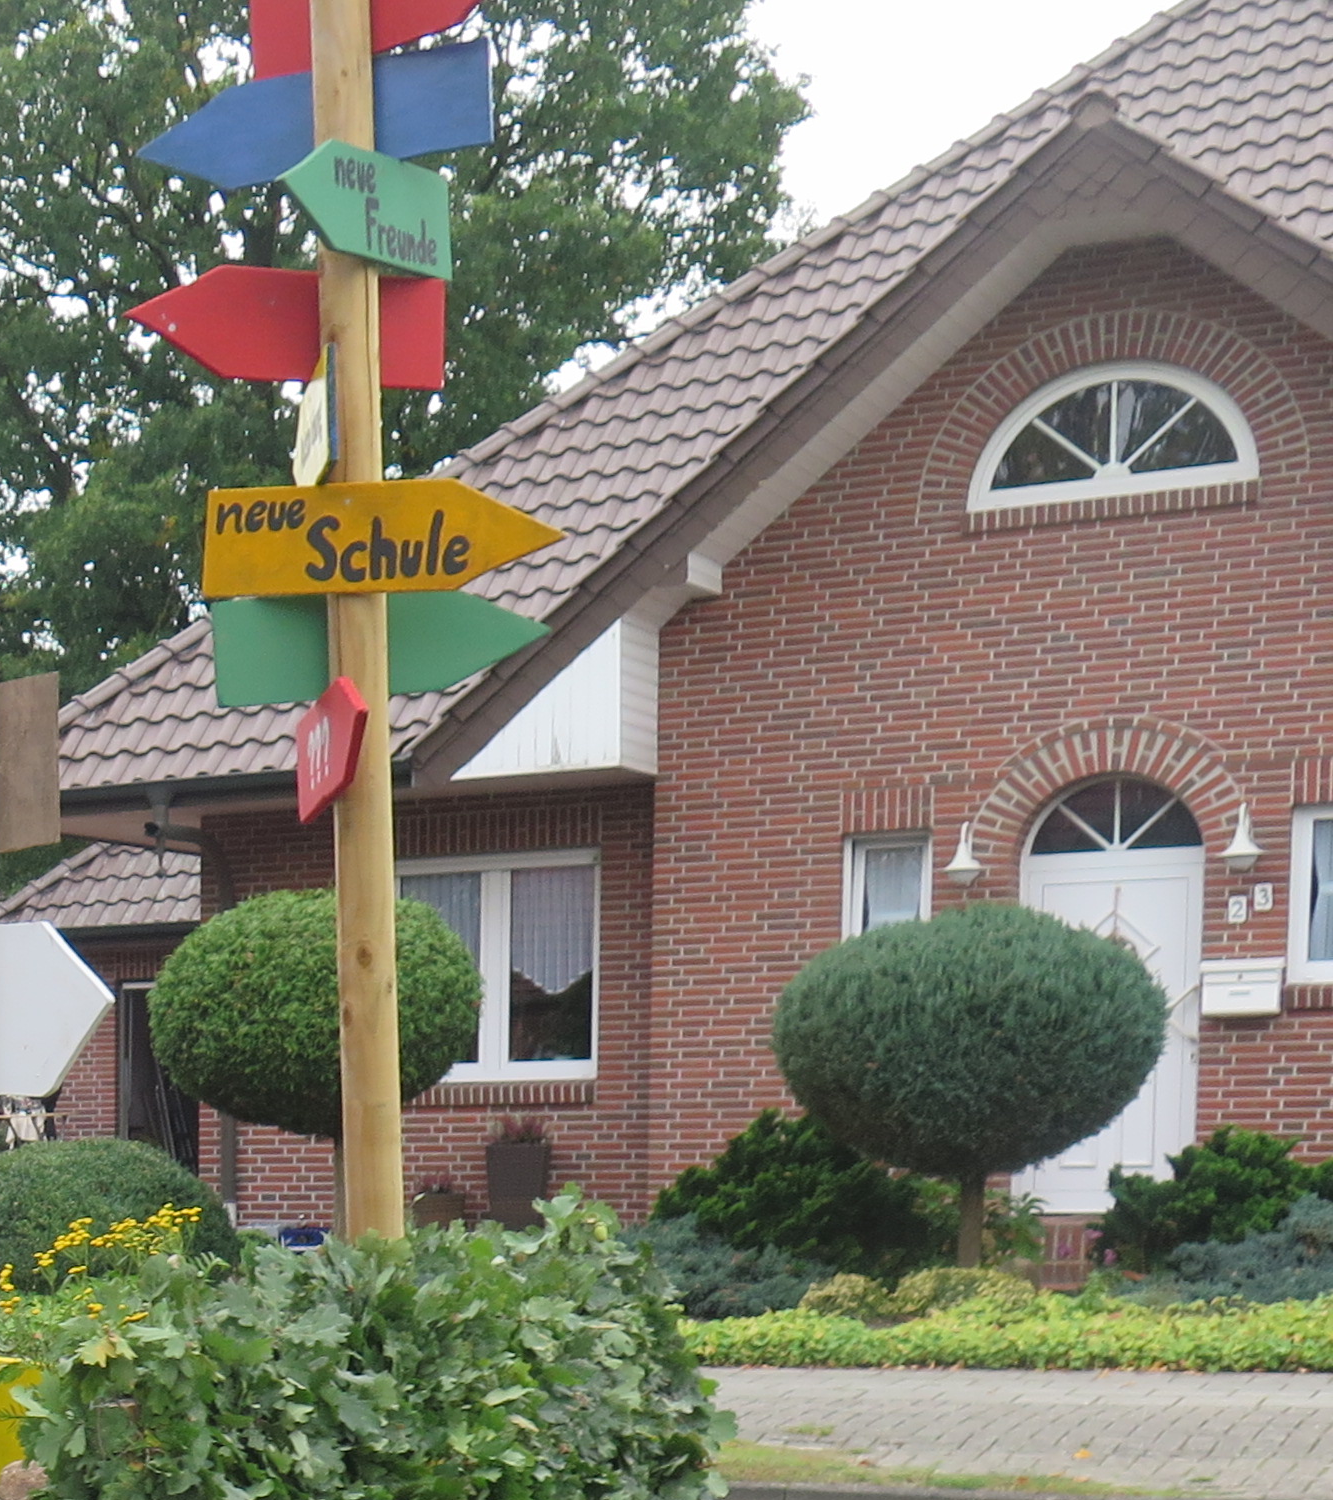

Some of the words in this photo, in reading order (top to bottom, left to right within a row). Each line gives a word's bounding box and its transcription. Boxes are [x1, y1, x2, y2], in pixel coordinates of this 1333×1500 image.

[334, 156, 376, 194] neue
[365, 196, 438, 266] Freunde
[216, 499, 306, 534] neue
[305, 509, 471, 582] Schule
